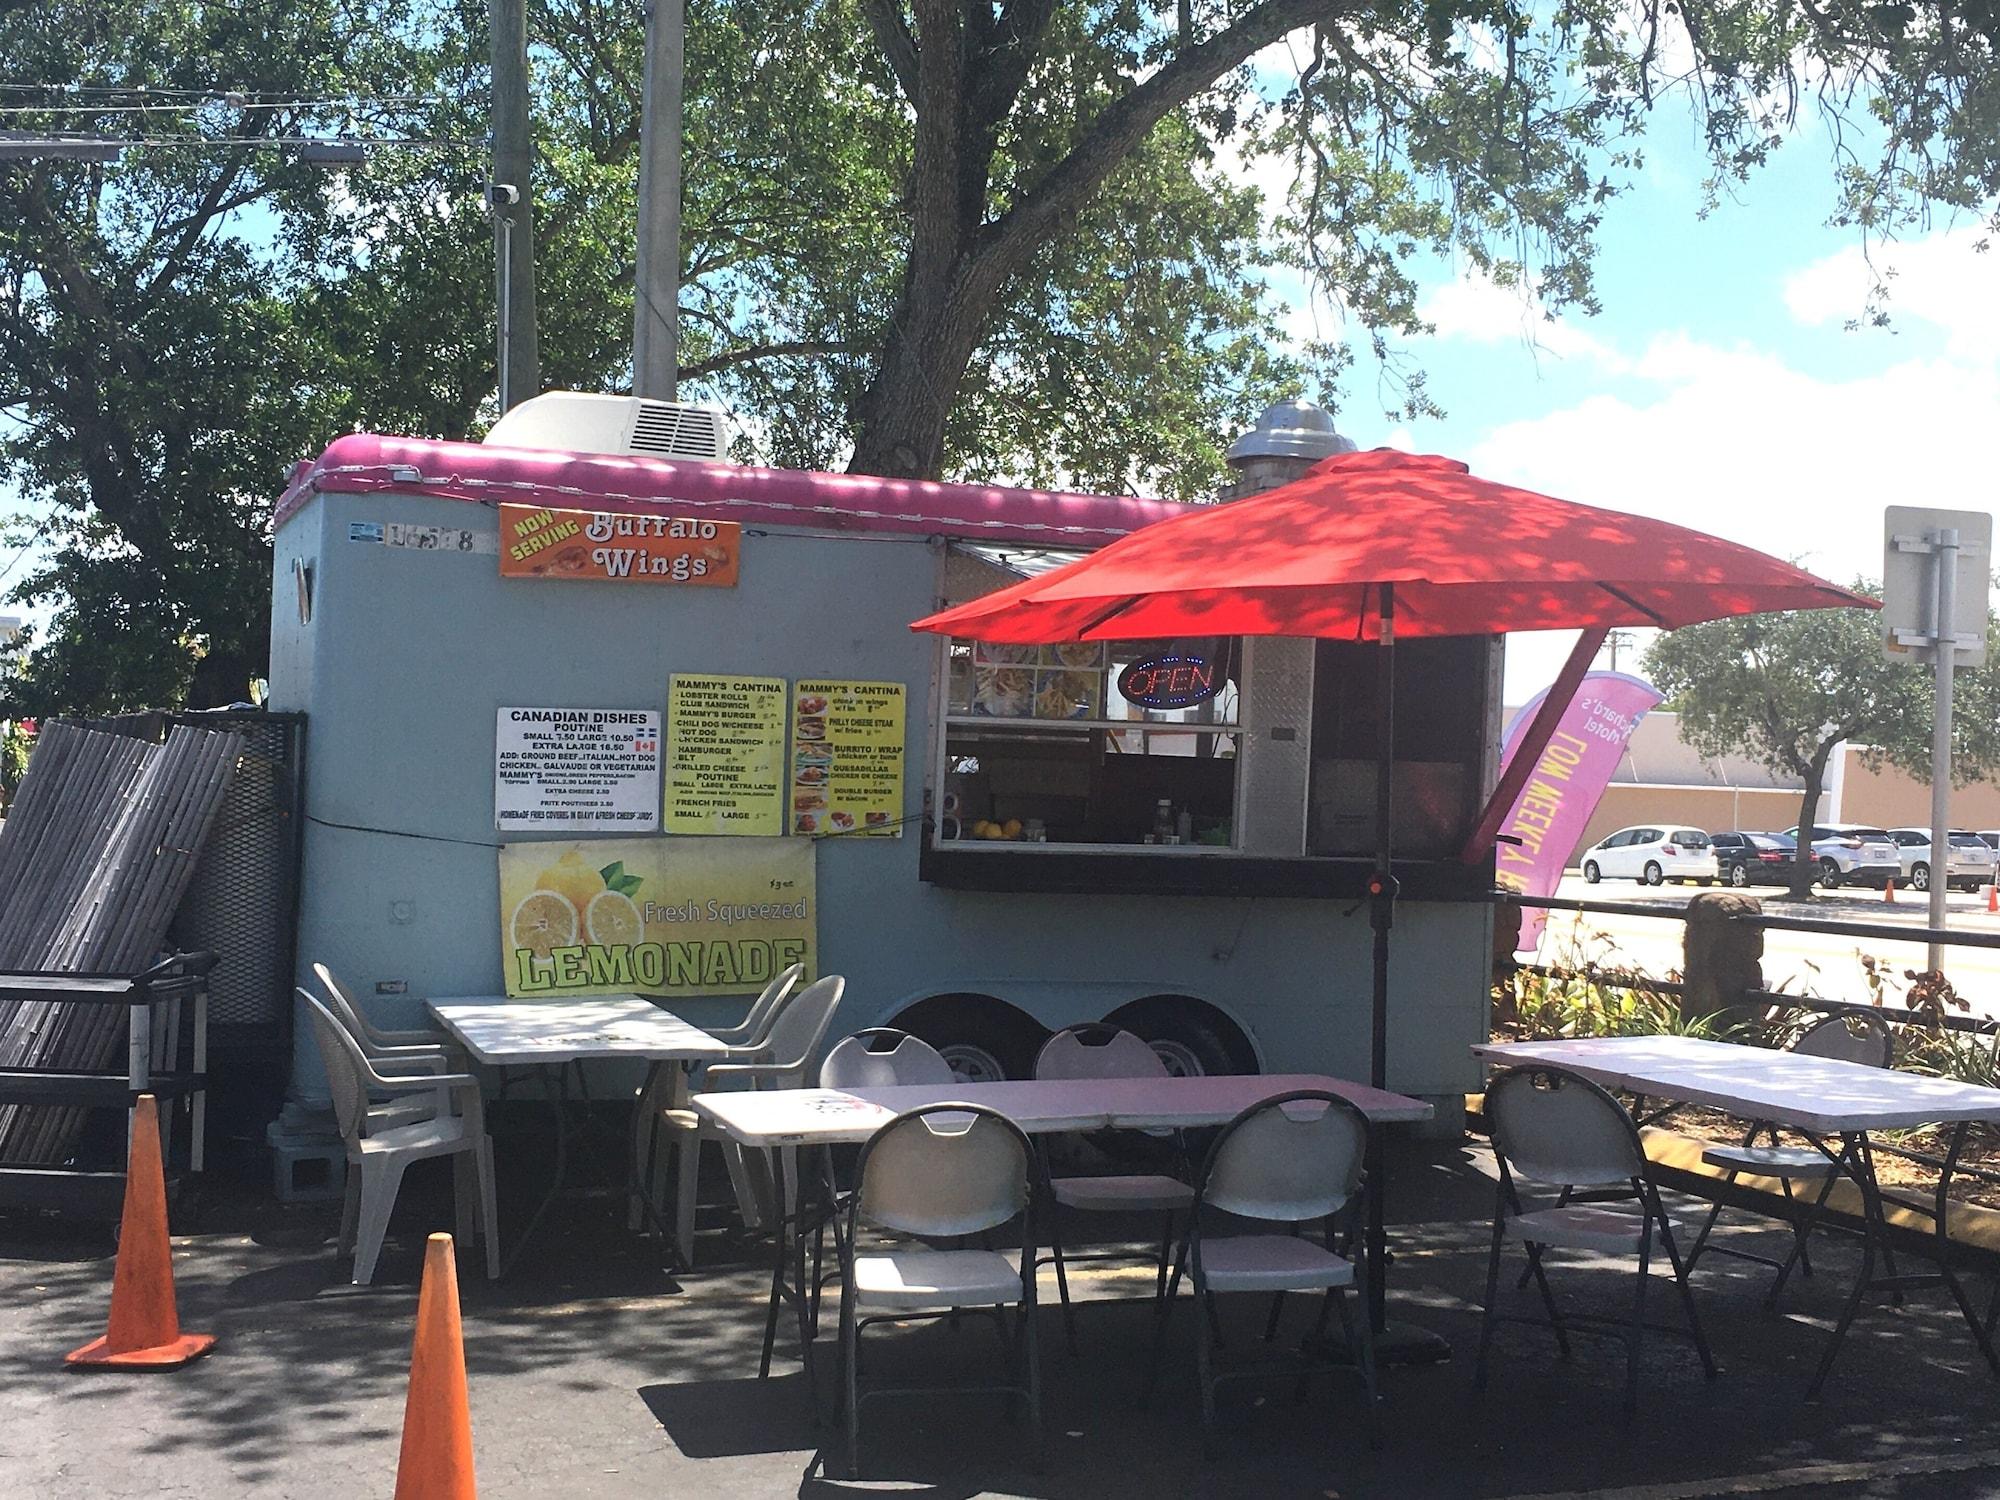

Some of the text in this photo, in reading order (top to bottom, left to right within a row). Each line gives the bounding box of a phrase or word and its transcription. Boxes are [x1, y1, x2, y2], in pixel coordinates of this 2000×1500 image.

[514, 510, 554, 537] NOW
[585, 514, 717, 542] Buffalo
[509, 519, 581, 561] SERVING
[592, 548, 708, 581] Wings
[1127, 665, 1214, 695] OPEN
[676, 680, 781, 693] MAMMY'S CANTINA
[800, 684, 900, 695] MAMMY'S CANTINA
[721, 693, 748, 701] ROLLS
[705, 701, 750, 709] SANDWICH
[511, 711, 647, 724] CANADIAN DISHES
[679, 709, 719, 717] MAMMY'S
[721, 711, 756, 719] BURGER
[554, 723, 604, 732] POUTINE
[701, 720, 720, 728] DOG
[829, 718, 894, 727] PHILLY CHEESE STEAK
[523, 732, 553, 740] SMALL
[610, 734, 634, 742] 10.50
[678, 746, 732, 755] HAMBURGER
[834, 745, 872, 753] BURRITO
[878, 746, 903, 754] WRAP
[521, 752, 556, 760] GROUND
[713, 764, 747, 772] CHEESE
[696, 773, 739, 781] POUTINE
[643, 897, 807, 929] Fresh Squeezed
[516, 938, 807, 991] LEMONADE
